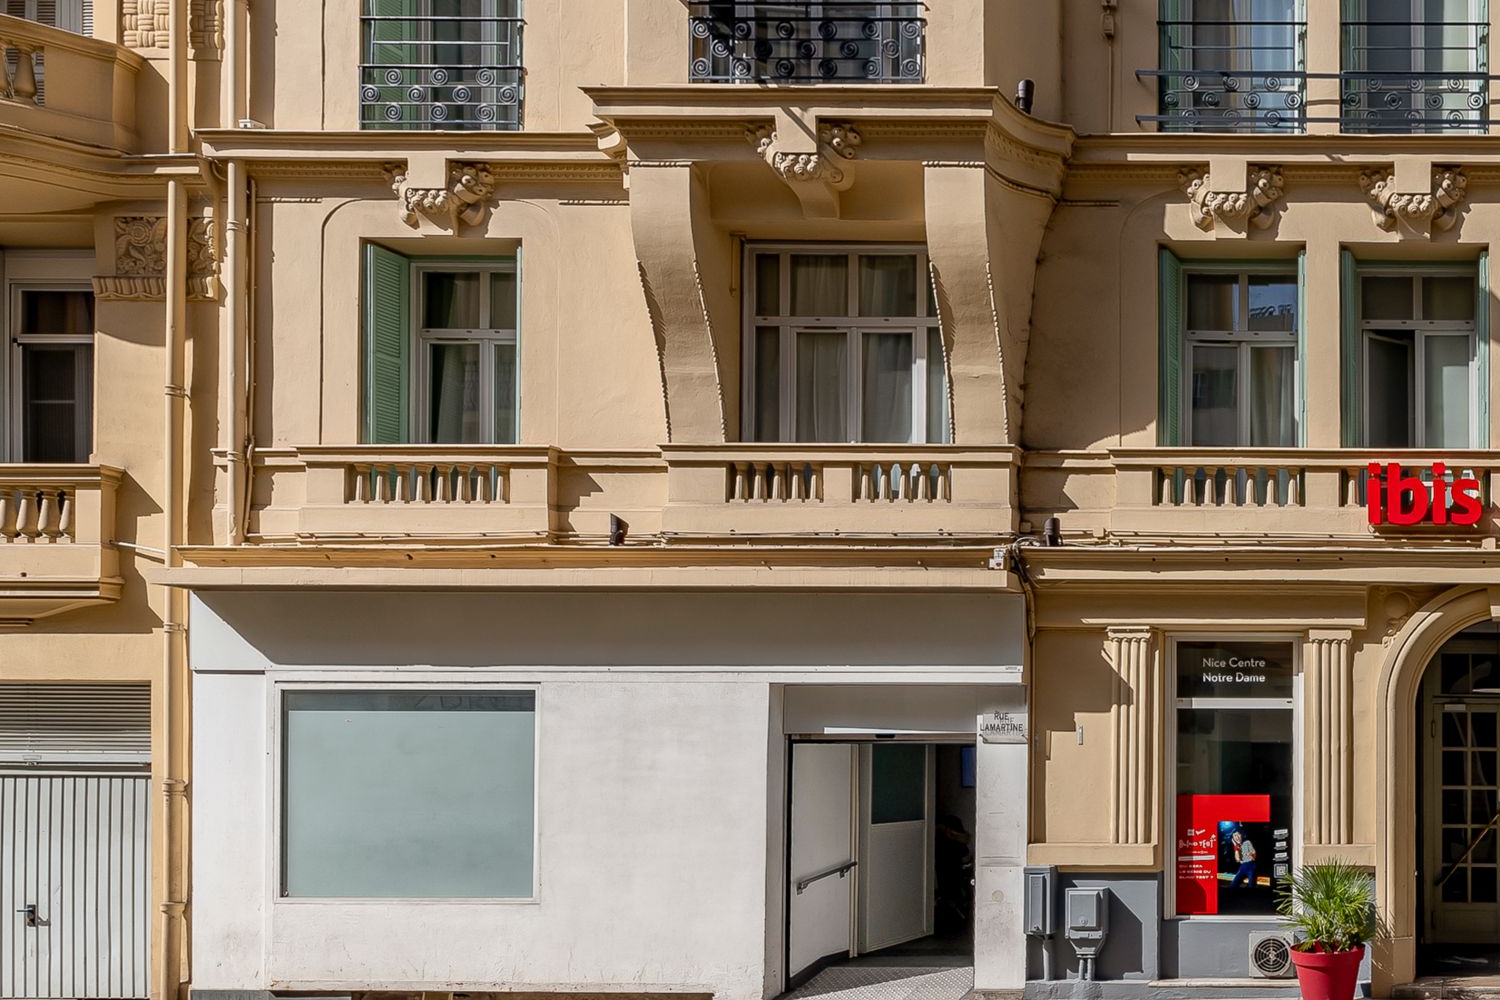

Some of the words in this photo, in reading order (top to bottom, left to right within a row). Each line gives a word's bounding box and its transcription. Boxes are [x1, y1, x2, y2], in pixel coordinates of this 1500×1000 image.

[1367, 461, 1482, 526] ibis
[1202, 657, 1226, 668] Nice
[1228, 657, 1266, 668] Centre
[1202, 672, 1233, 682] Notre
[1235, 672, 1266, 682] Dame
[993, 712, 1010, 721] RUE
[979, 723, 1024, 732] LAMARTINE
